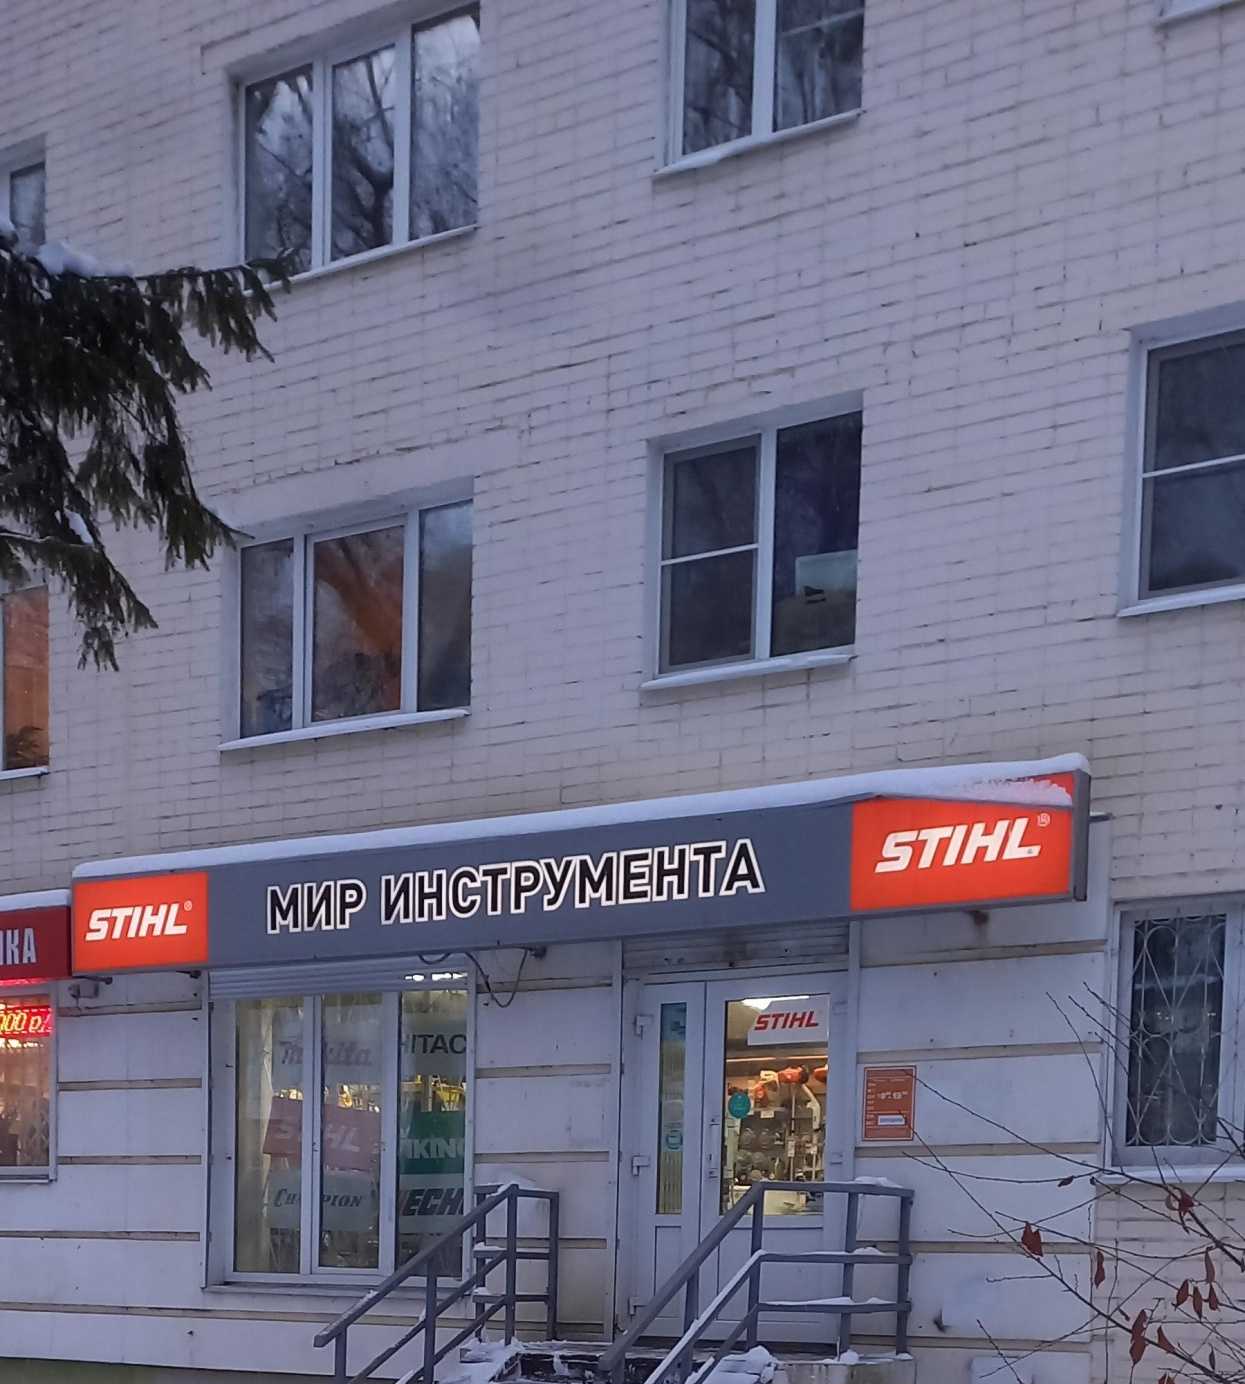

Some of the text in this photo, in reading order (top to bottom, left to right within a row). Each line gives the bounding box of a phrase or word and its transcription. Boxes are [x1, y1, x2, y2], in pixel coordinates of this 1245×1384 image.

[267, 838, 766, 934] МИР ИНСТРУМЕНТА
[754, 1010, 820, 1031] STIHL
[401, 1033, 467, 1055] ITAC
[403, 1187, 465, 1217] ECH
